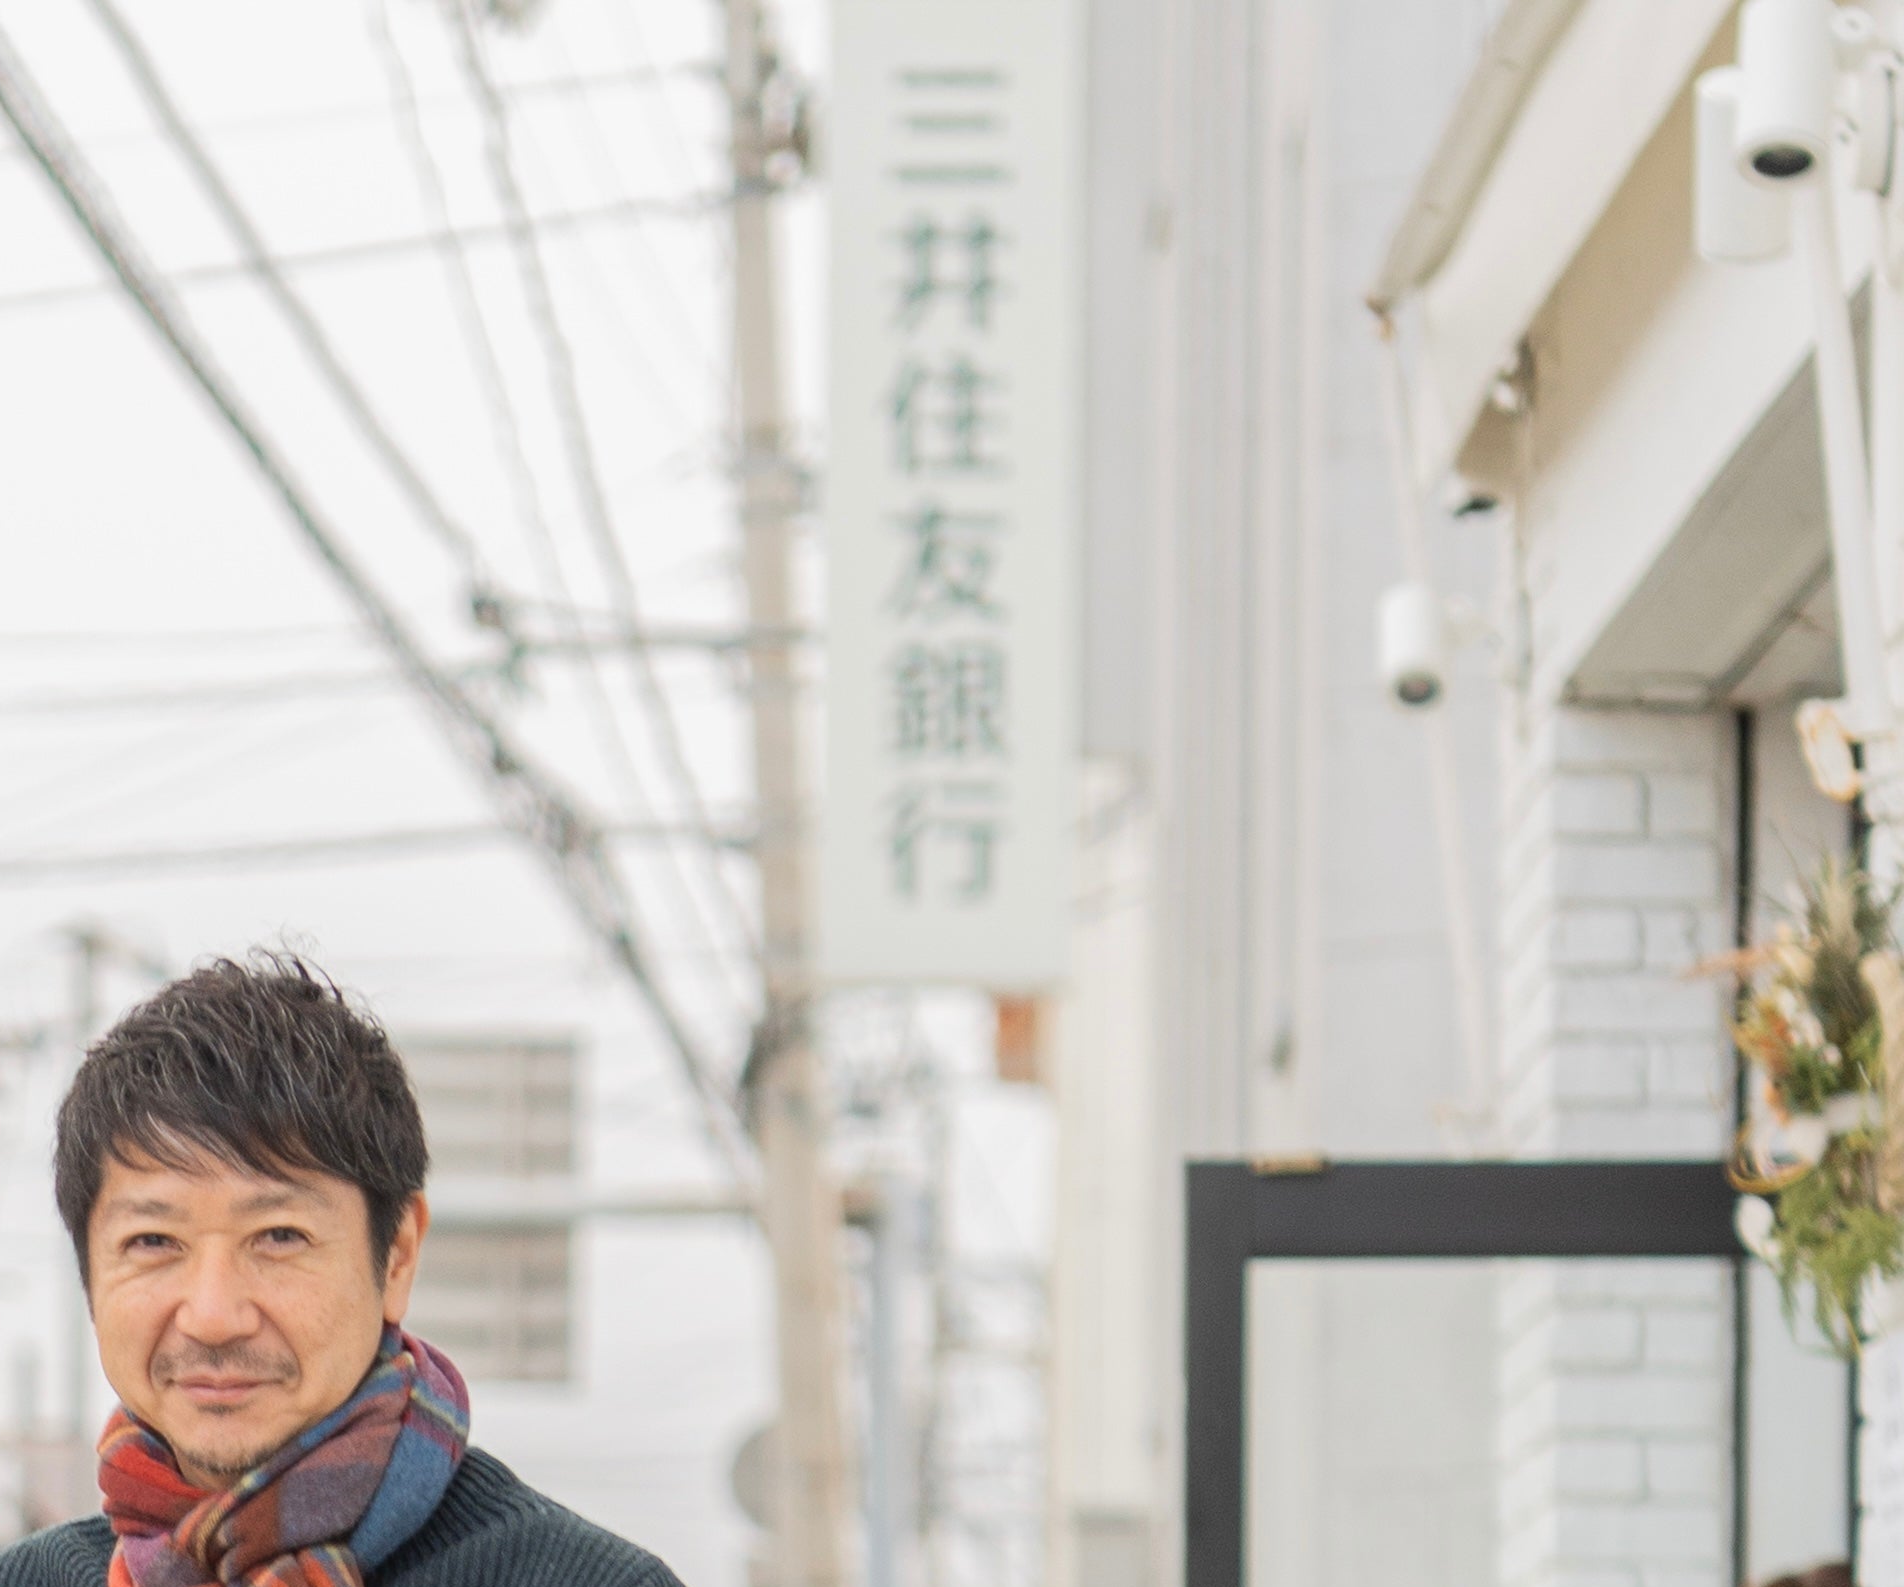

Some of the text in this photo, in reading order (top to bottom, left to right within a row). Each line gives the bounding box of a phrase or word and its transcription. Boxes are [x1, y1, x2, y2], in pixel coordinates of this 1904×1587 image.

[886, 66, 1014, 906] 三井住友銀行
